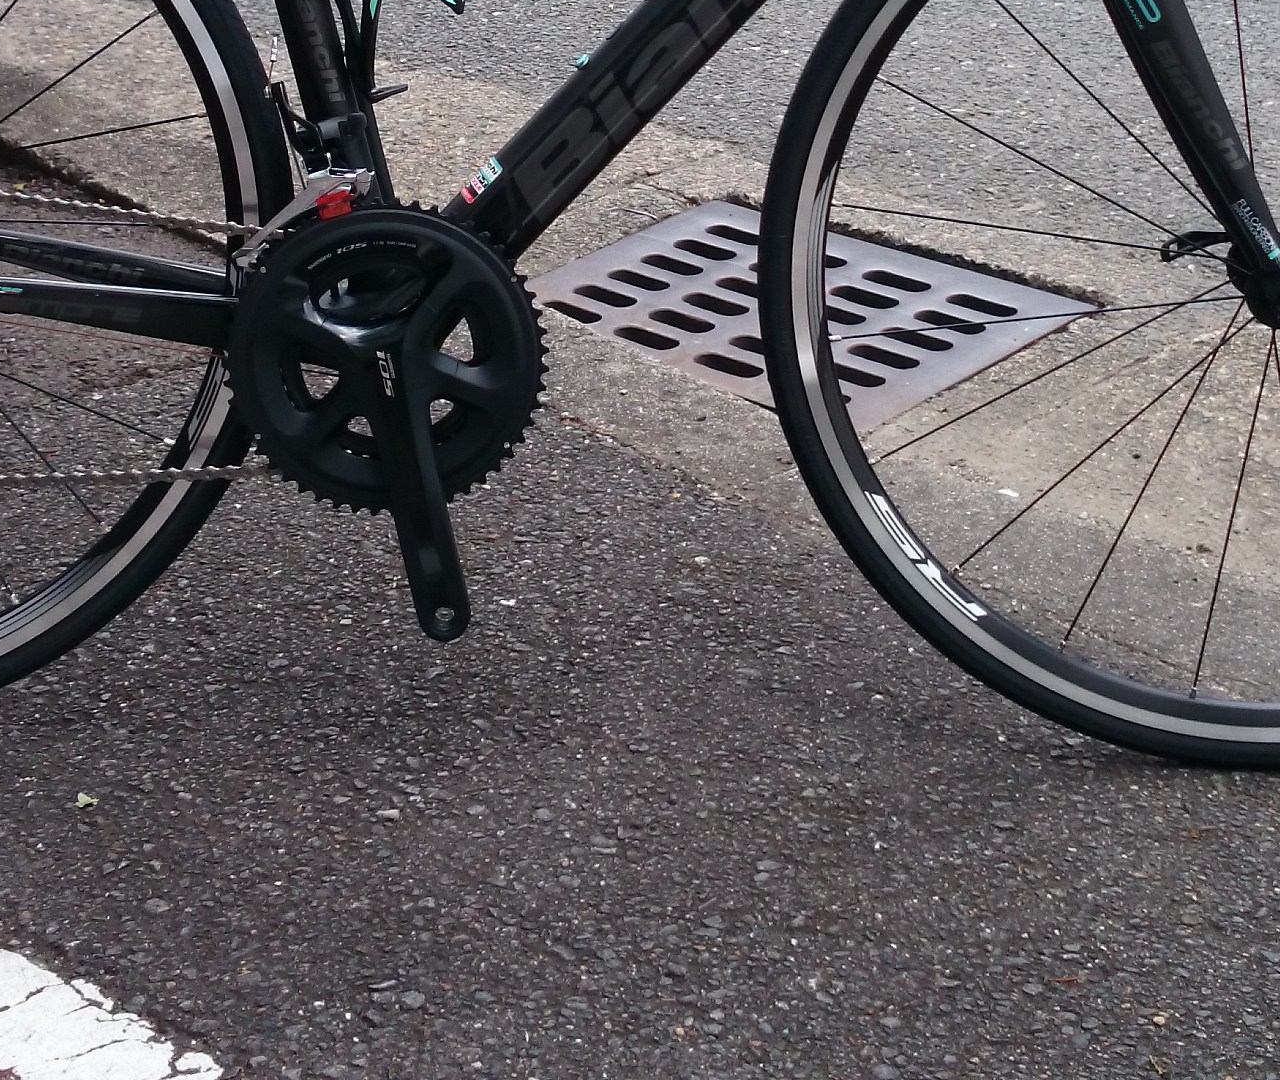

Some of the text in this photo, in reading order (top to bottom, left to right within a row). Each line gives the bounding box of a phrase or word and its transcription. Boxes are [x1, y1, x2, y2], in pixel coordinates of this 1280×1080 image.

[1150, 40, 1248, 171] Bianchi
[336, 241, 368, 255] 105
[1236, 198, 1278, 251] FULL CARBON
[376, 350, 395, 398] 105
[863, 490, 988, 623] RS
